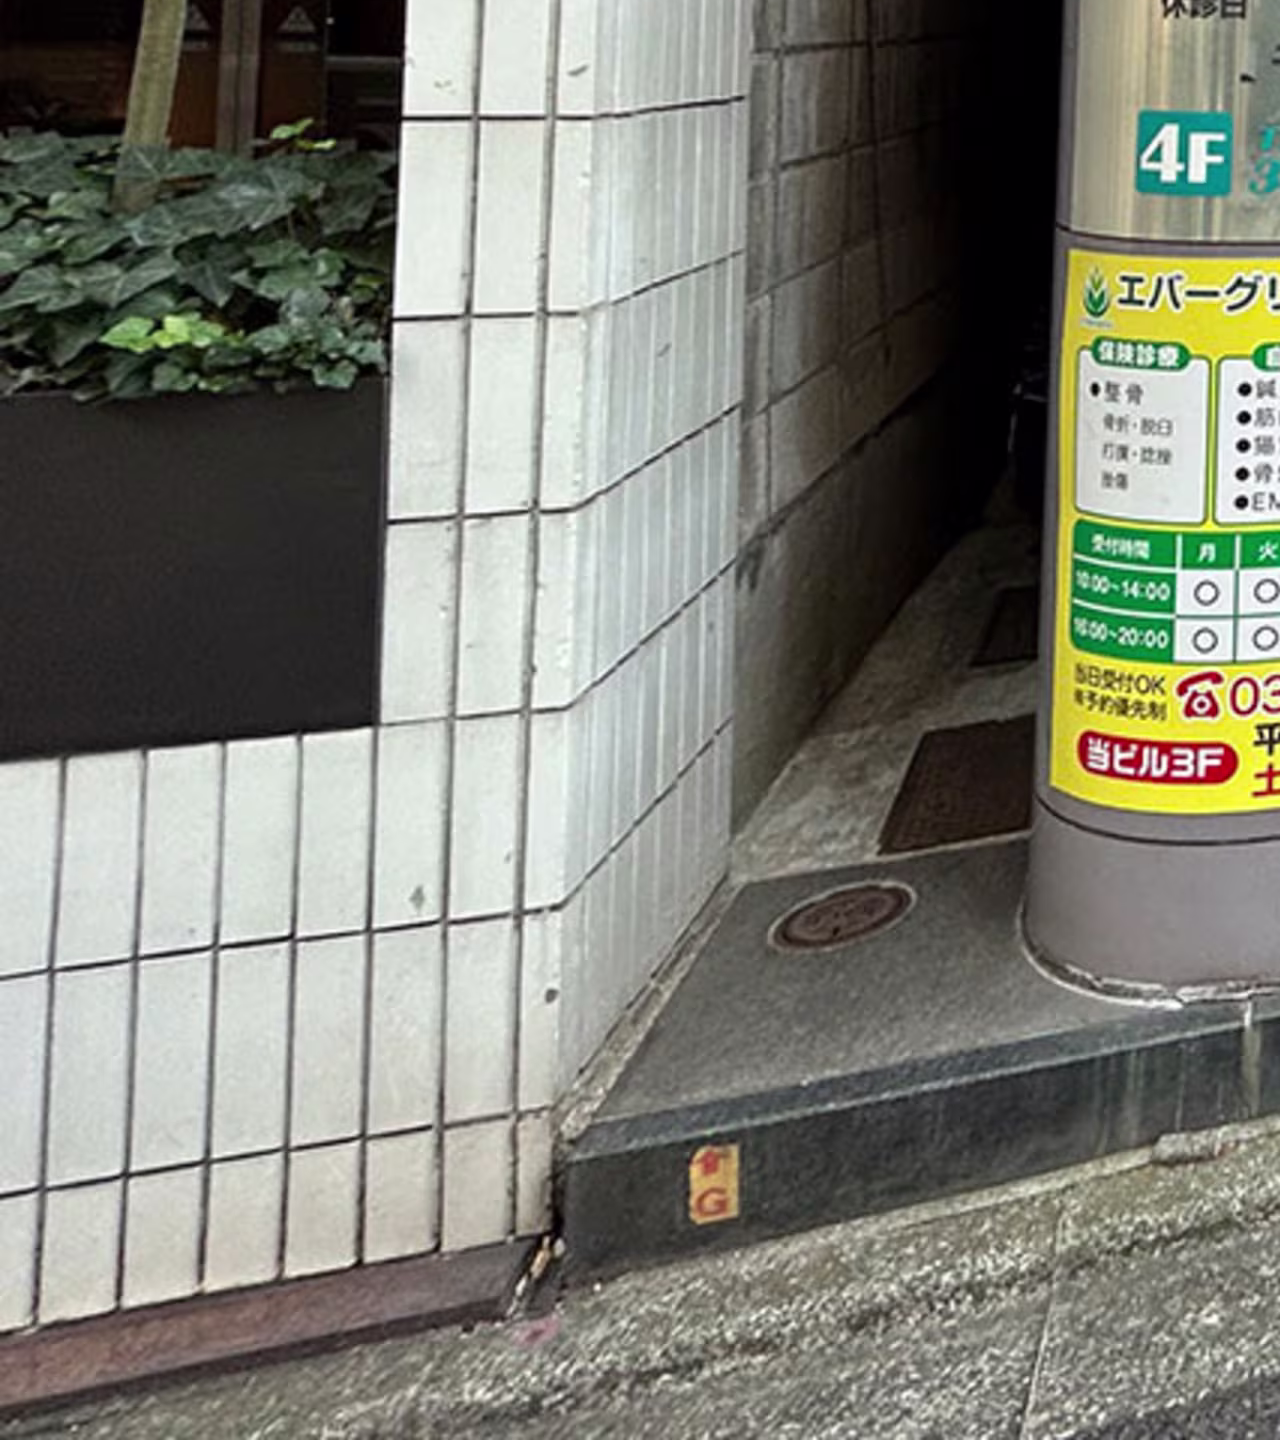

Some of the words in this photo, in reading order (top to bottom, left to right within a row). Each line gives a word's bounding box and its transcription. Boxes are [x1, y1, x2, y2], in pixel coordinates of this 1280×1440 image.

[1140, 123, 1226, 184] 4F
[1198, 542, 1216, 563] 月
[1259, 541, 1278, 561] 火
[1086, 736, 1225, 779] 当ビル3F
